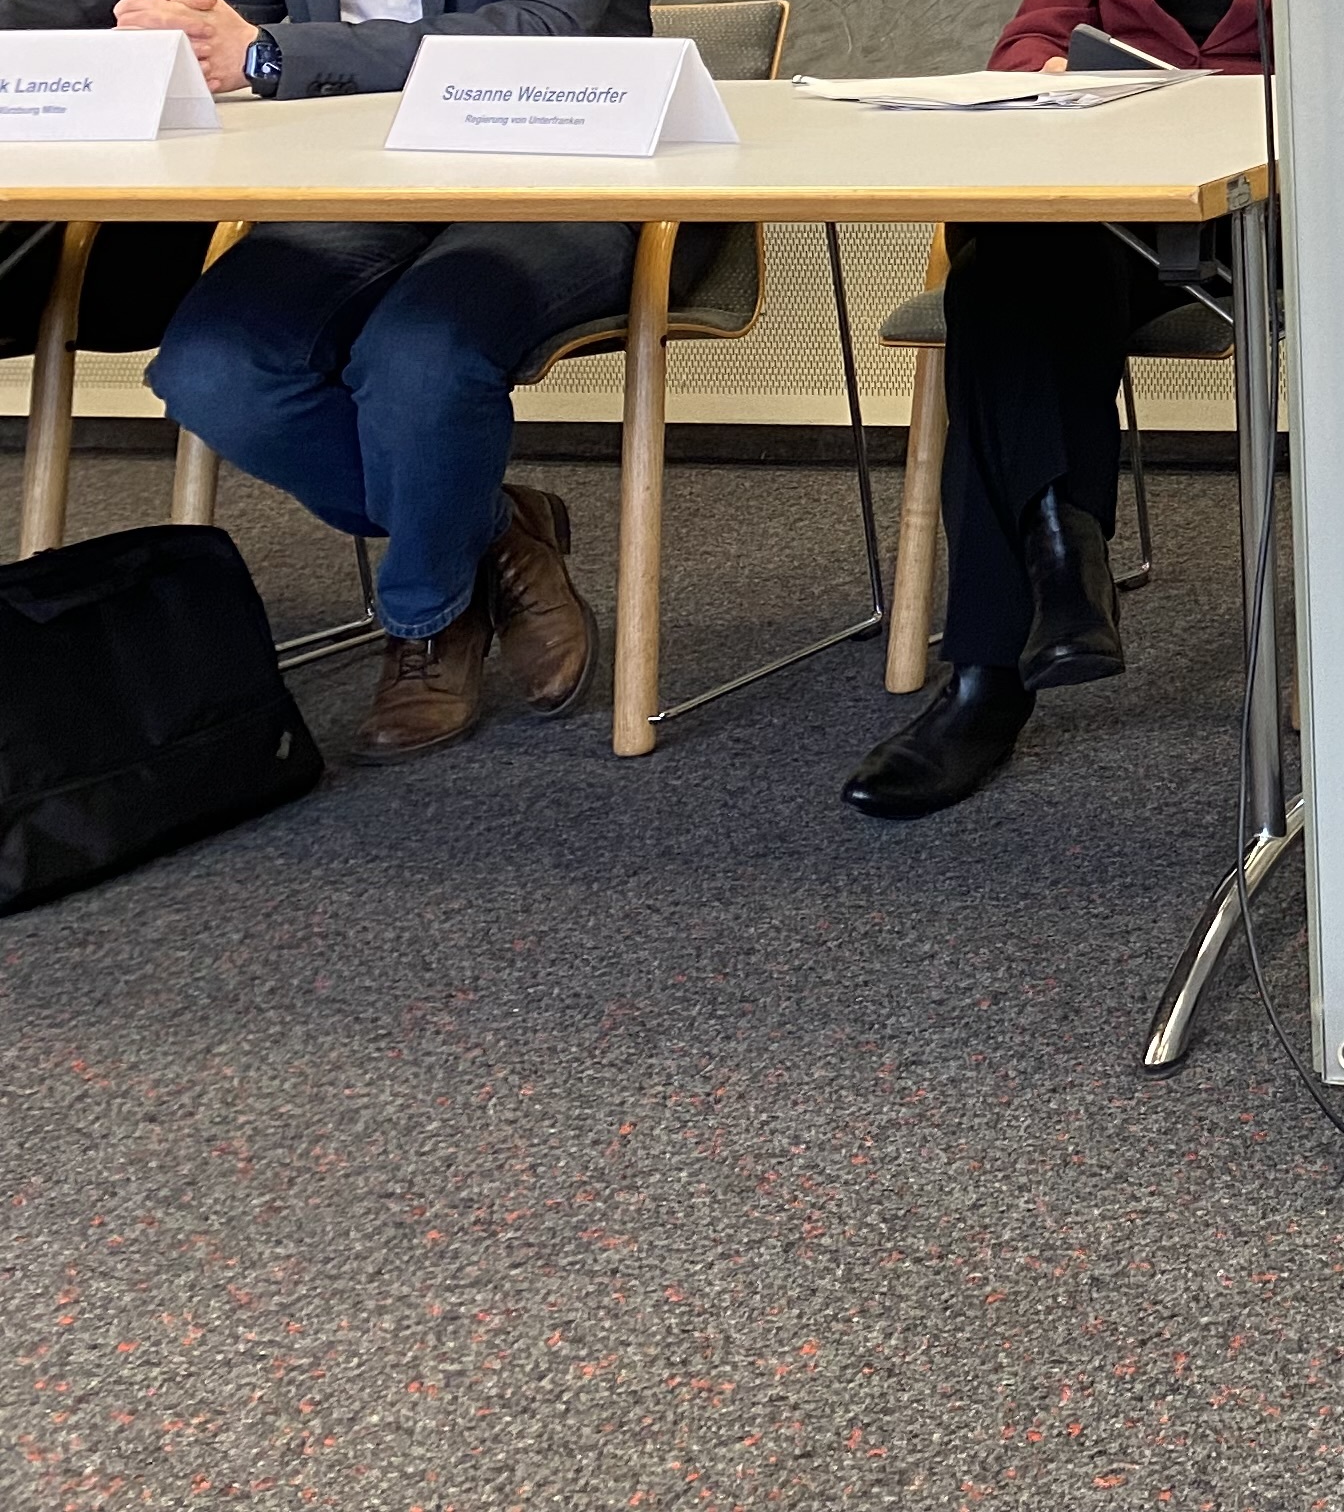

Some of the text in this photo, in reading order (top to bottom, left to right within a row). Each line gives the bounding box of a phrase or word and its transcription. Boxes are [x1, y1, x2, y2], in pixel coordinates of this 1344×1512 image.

[14, 77, 93, 93] Landeck
[442, 85, 628, 104] Susanne Weizendörfer
[465, 114, 586, 125] Regierung von Unterfranken
